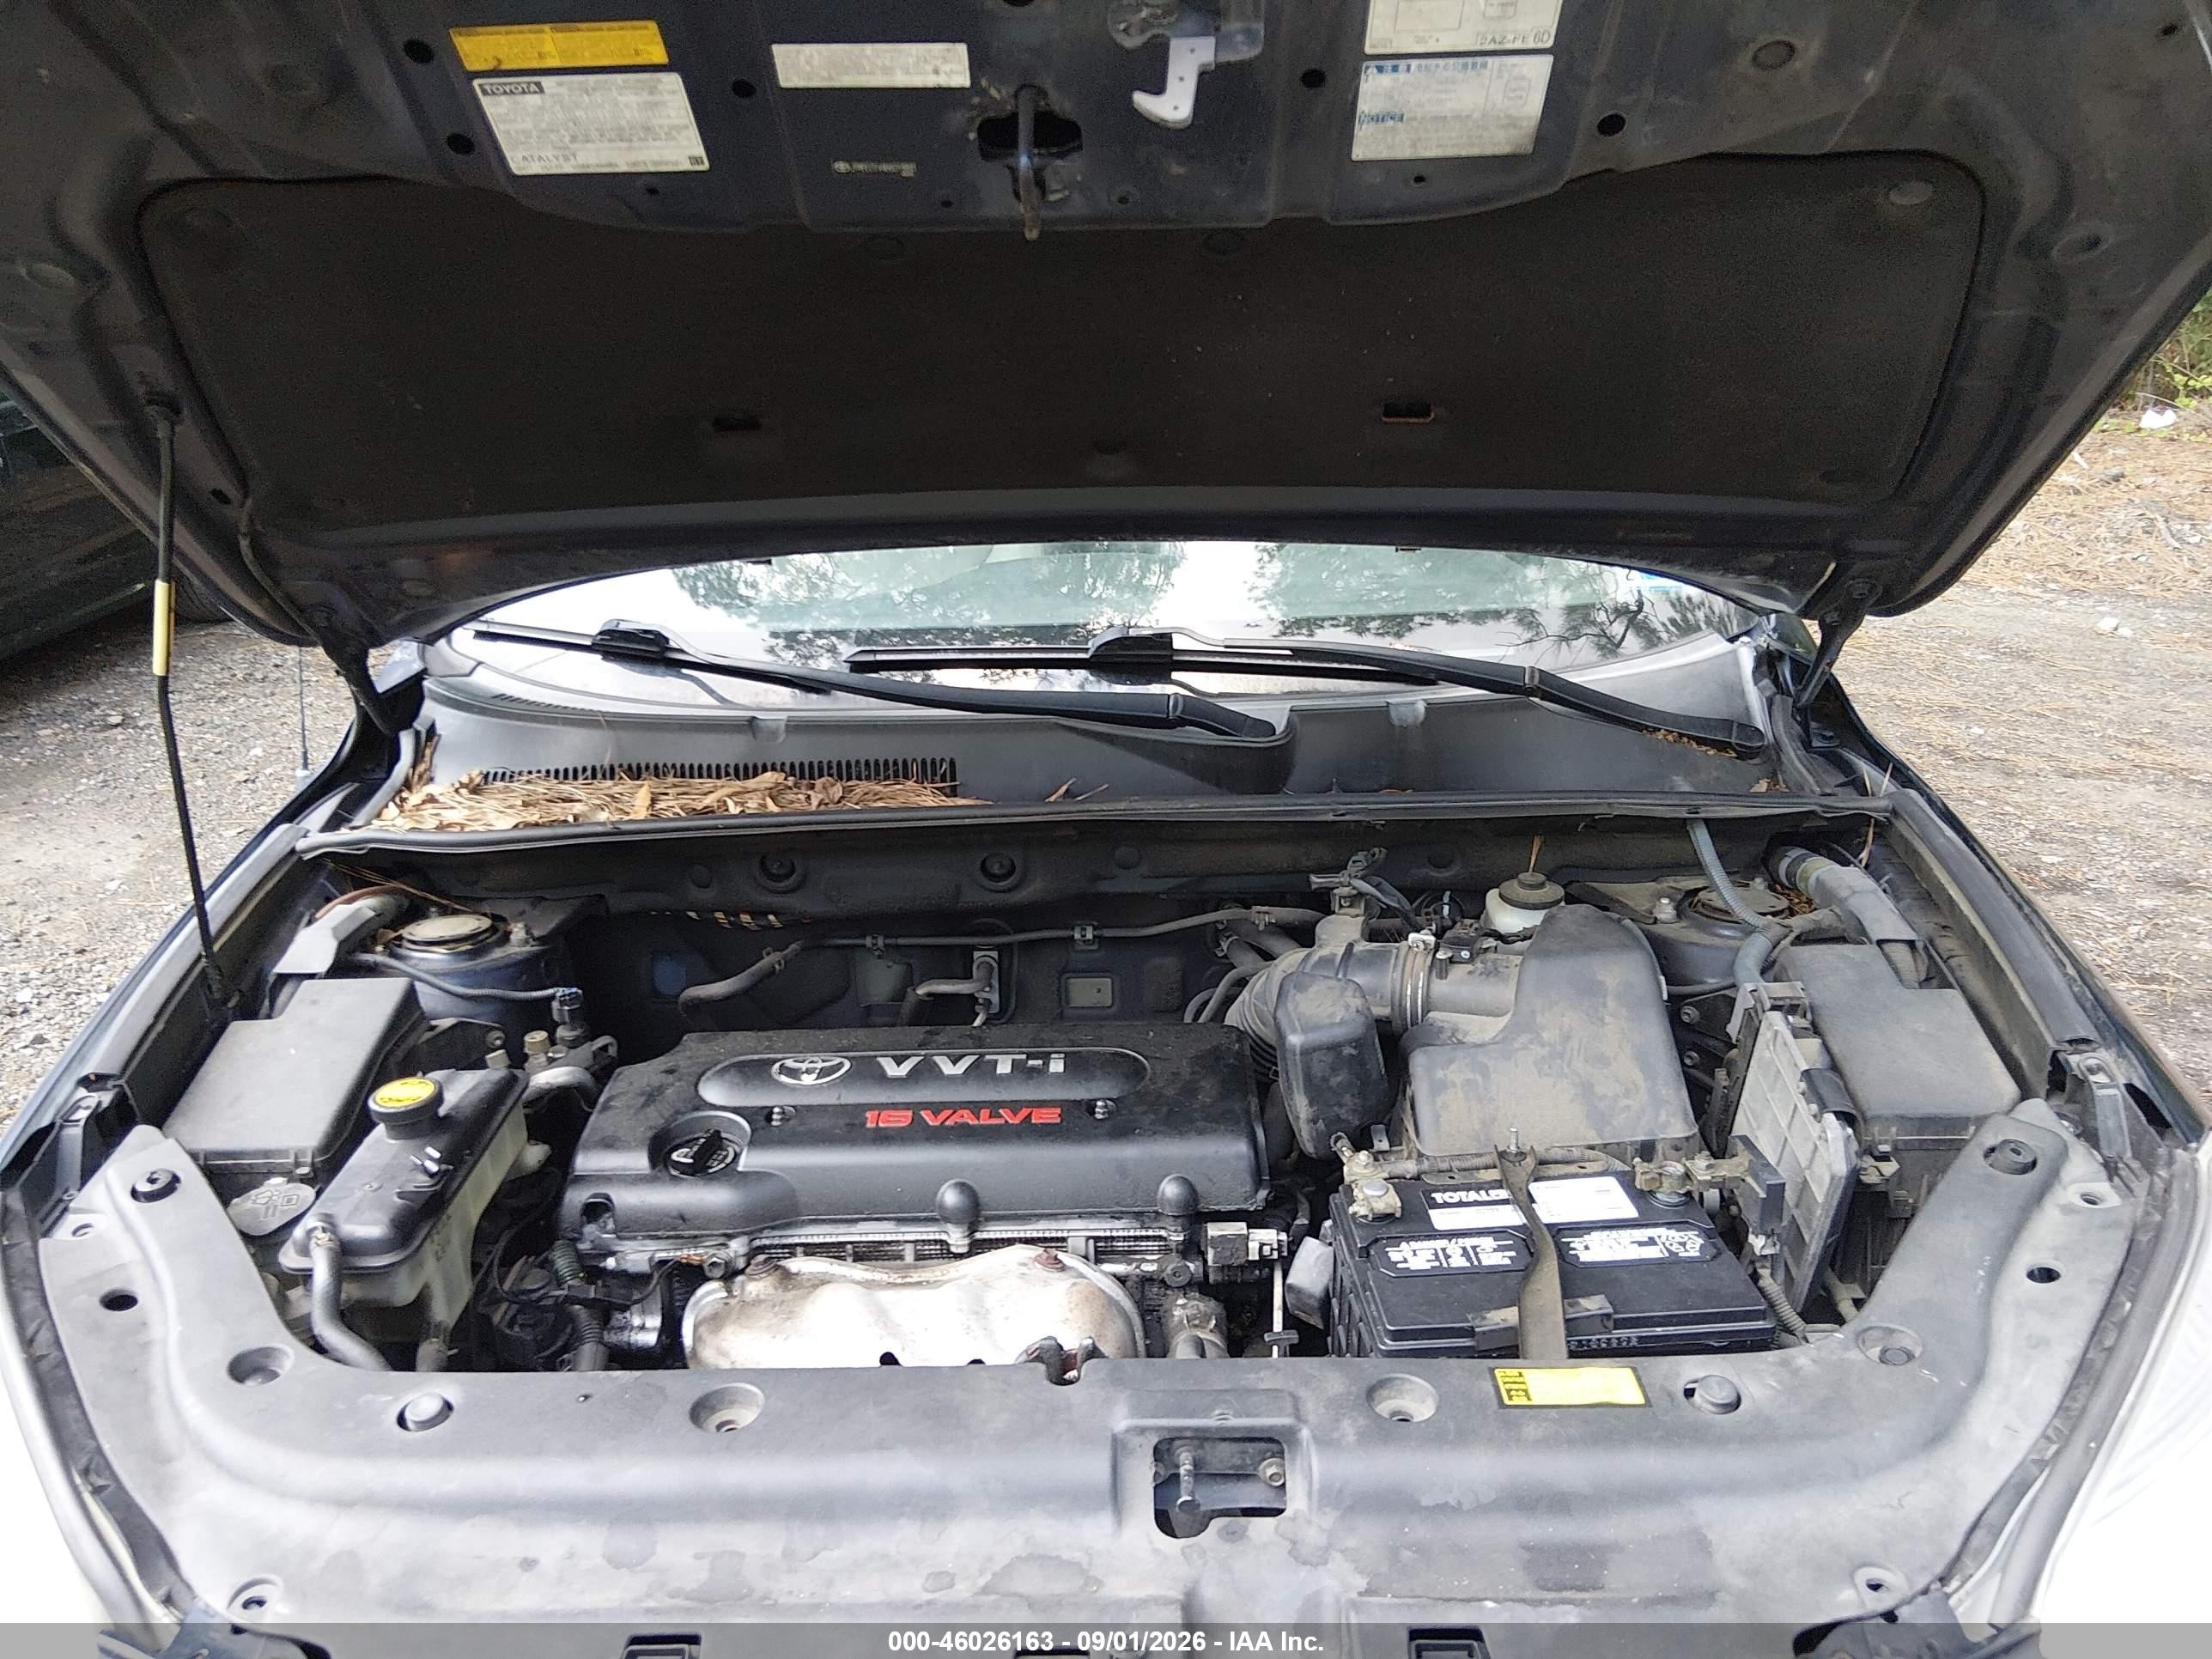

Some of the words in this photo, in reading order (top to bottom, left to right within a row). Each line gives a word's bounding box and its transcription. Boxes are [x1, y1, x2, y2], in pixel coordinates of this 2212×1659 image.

[482, 82, 540, 94] TOYOTA
[876, 1052, 1066, 1079] VVT-i
[865, 1109, 913, 1127] 16
[920, 1107, 1061, 1125] VALVE
